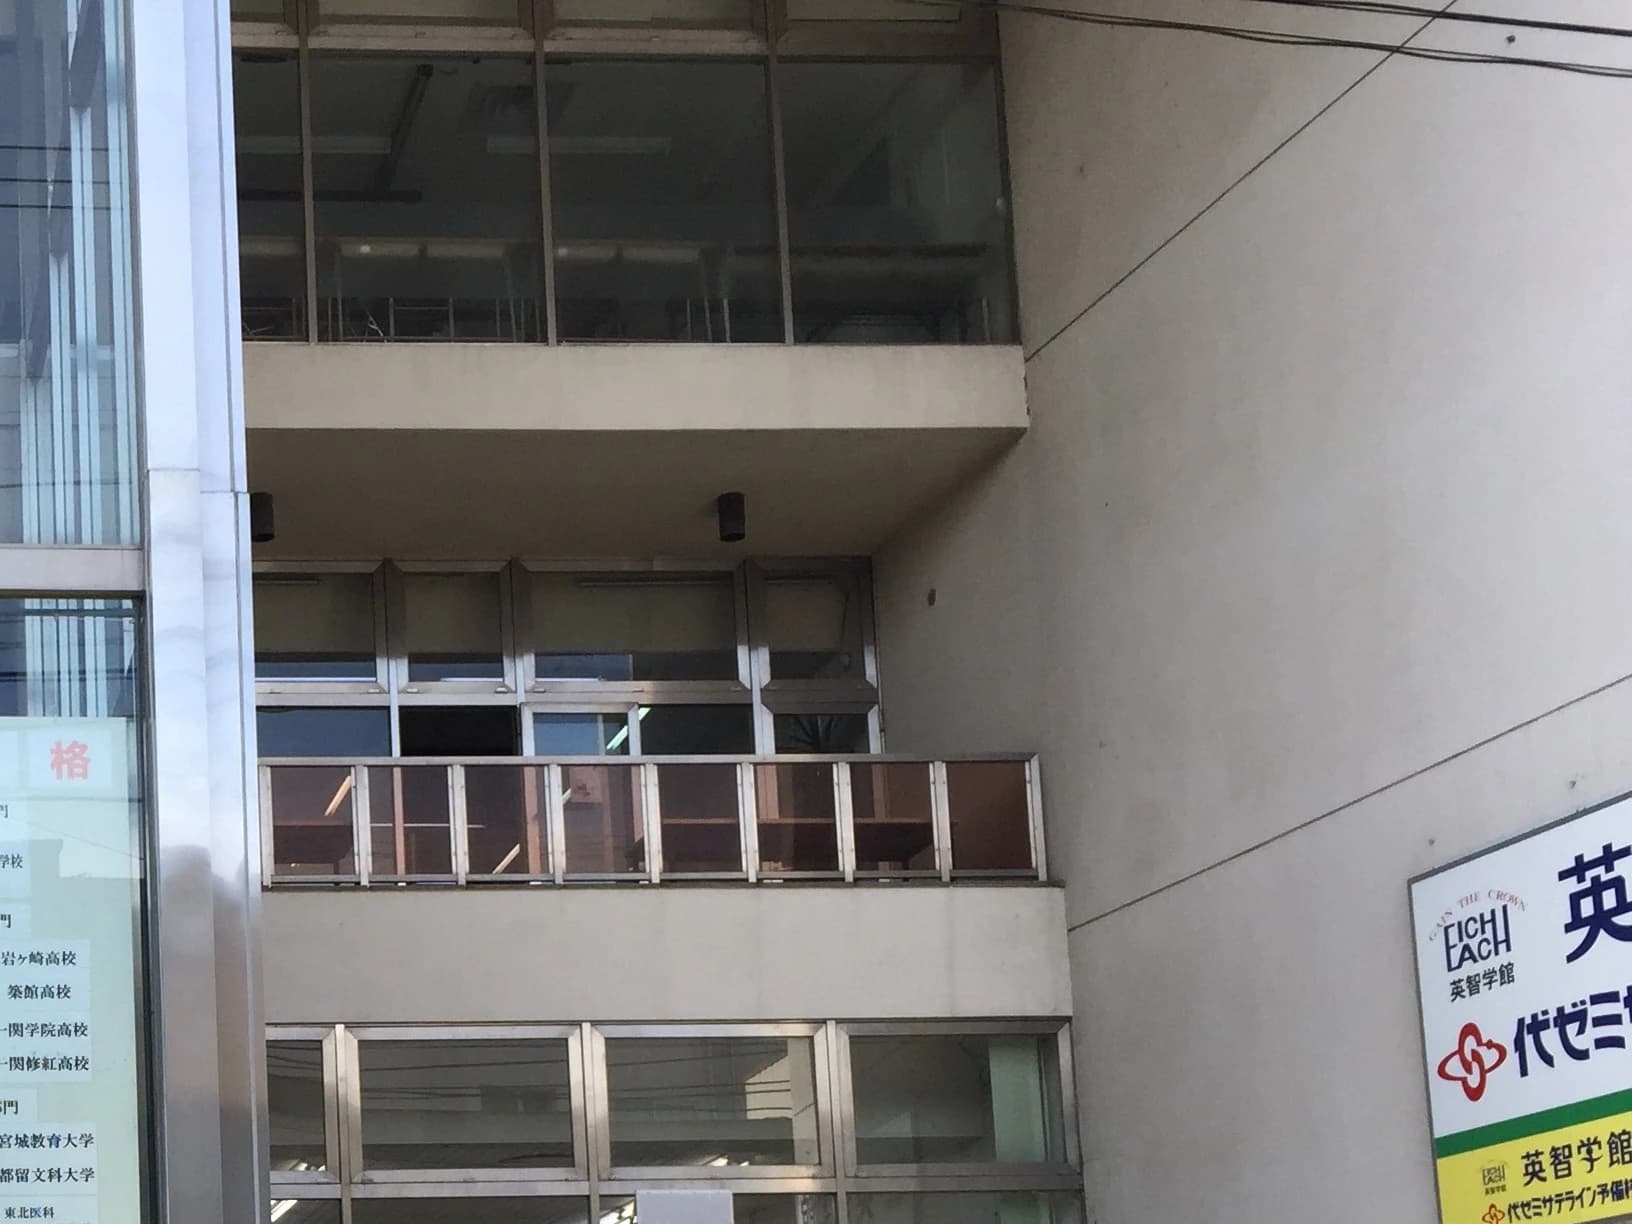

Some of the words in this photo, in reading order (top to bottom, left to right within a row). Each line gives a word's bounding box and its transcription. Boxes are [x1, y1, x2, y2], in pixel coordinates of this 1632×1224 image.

[1558, 842, 1632, 965] 英
[8, 984, 71, 999] 築館高校
[1450, 961, 1515, 1003] 英智学館
[1513, 985, 1632, 1078] 代ゼミ
[1521, 1129, 1632, 1187] 英智学館
[4, 1207, 55, 1219] 東北医科
